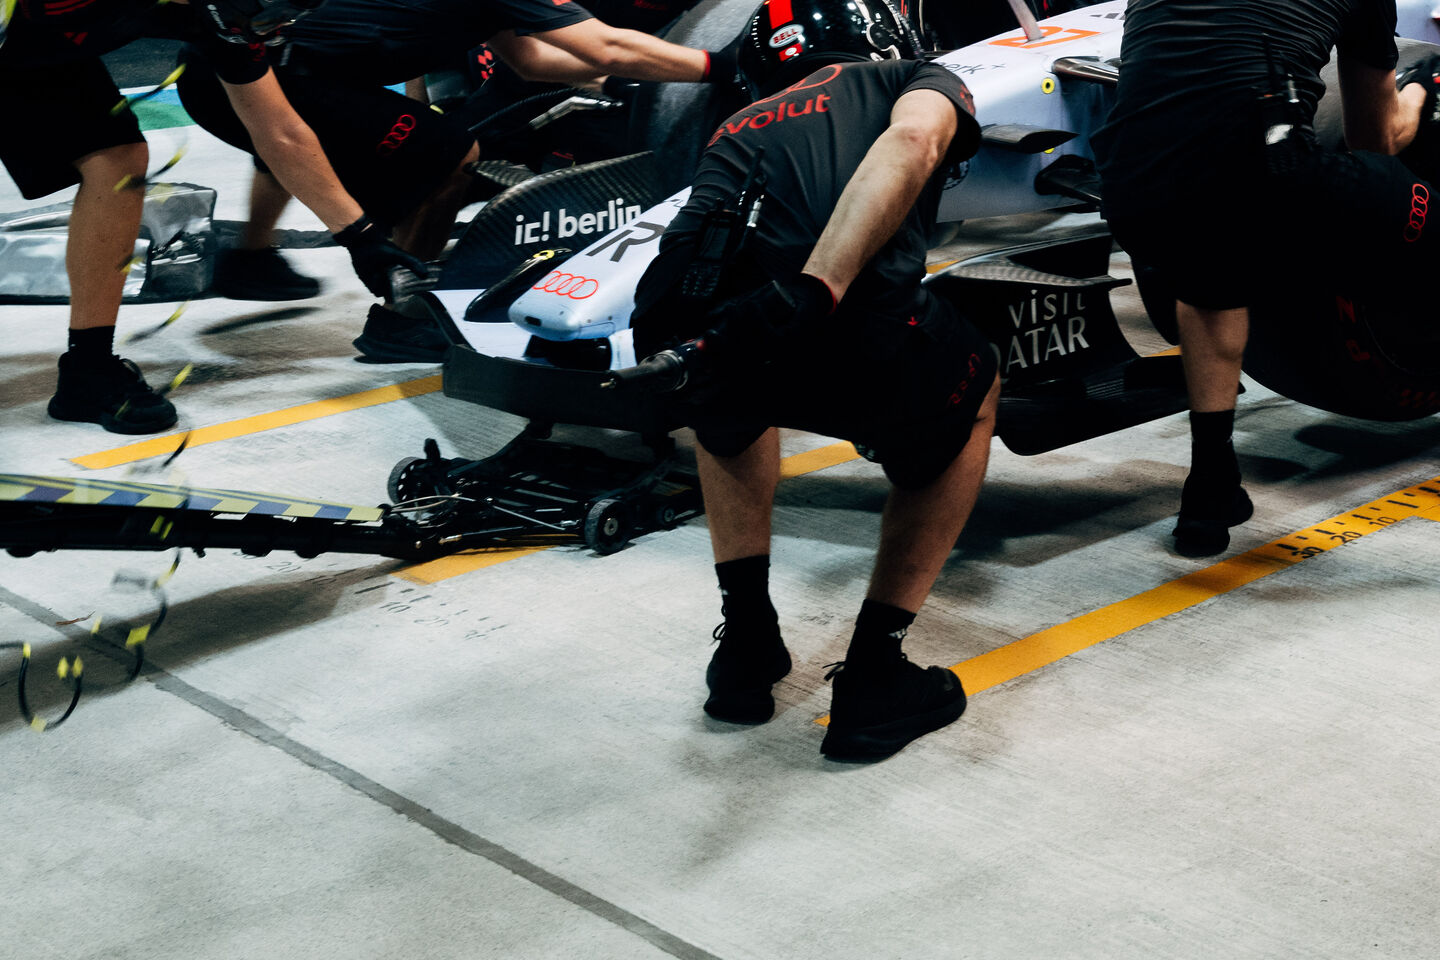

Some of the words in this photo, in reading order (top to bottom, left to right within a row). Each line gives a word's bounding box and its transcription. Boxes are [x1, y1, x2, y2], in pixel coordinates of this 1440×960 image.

[773, 28, 798, 45] BELL
[558, 197, 641, 238] berlin
[1369, 516, 1398, 527] 10
[1330, 531, 1363, 544] 20
